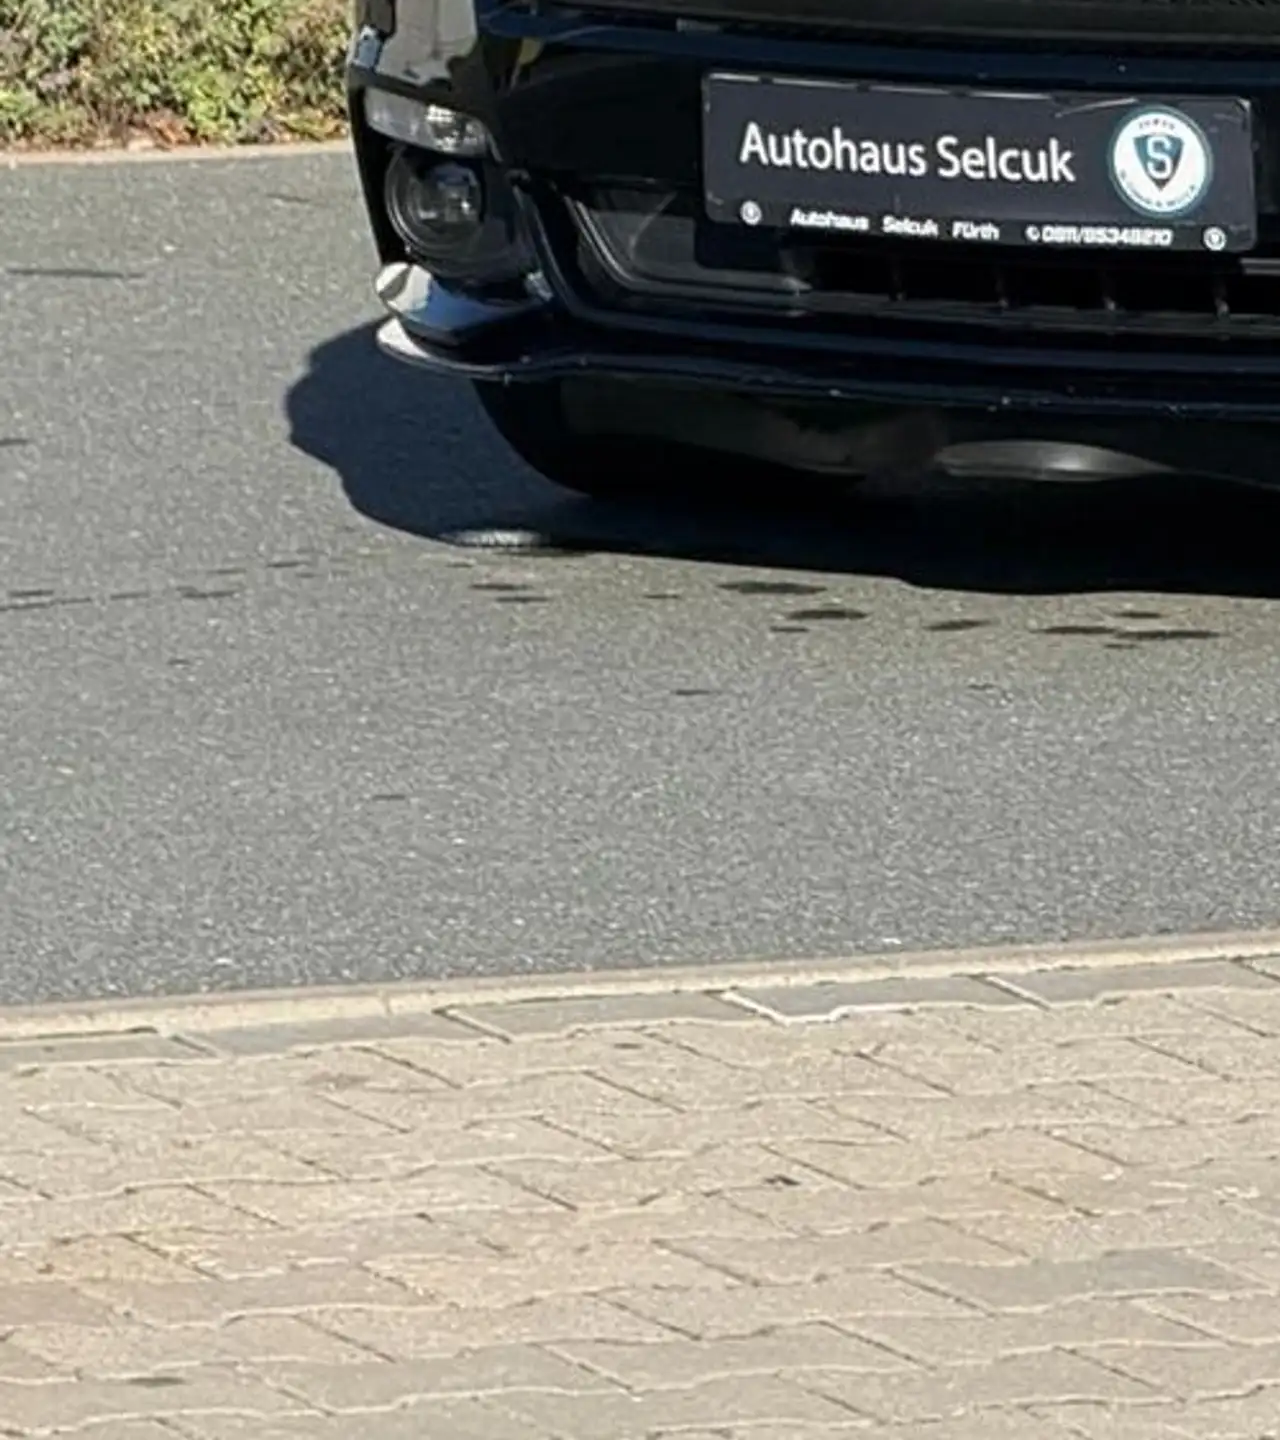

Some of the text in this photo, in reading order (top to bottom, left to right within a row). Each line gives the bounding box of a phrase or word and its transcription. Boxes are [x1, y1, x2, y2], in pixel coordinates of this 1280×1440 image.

[740, 122, 1075, 182] Autohaus Selcuk
[790, 209, 869, 230] Autohaus
[883, 216, 938, 236] Selcuk
